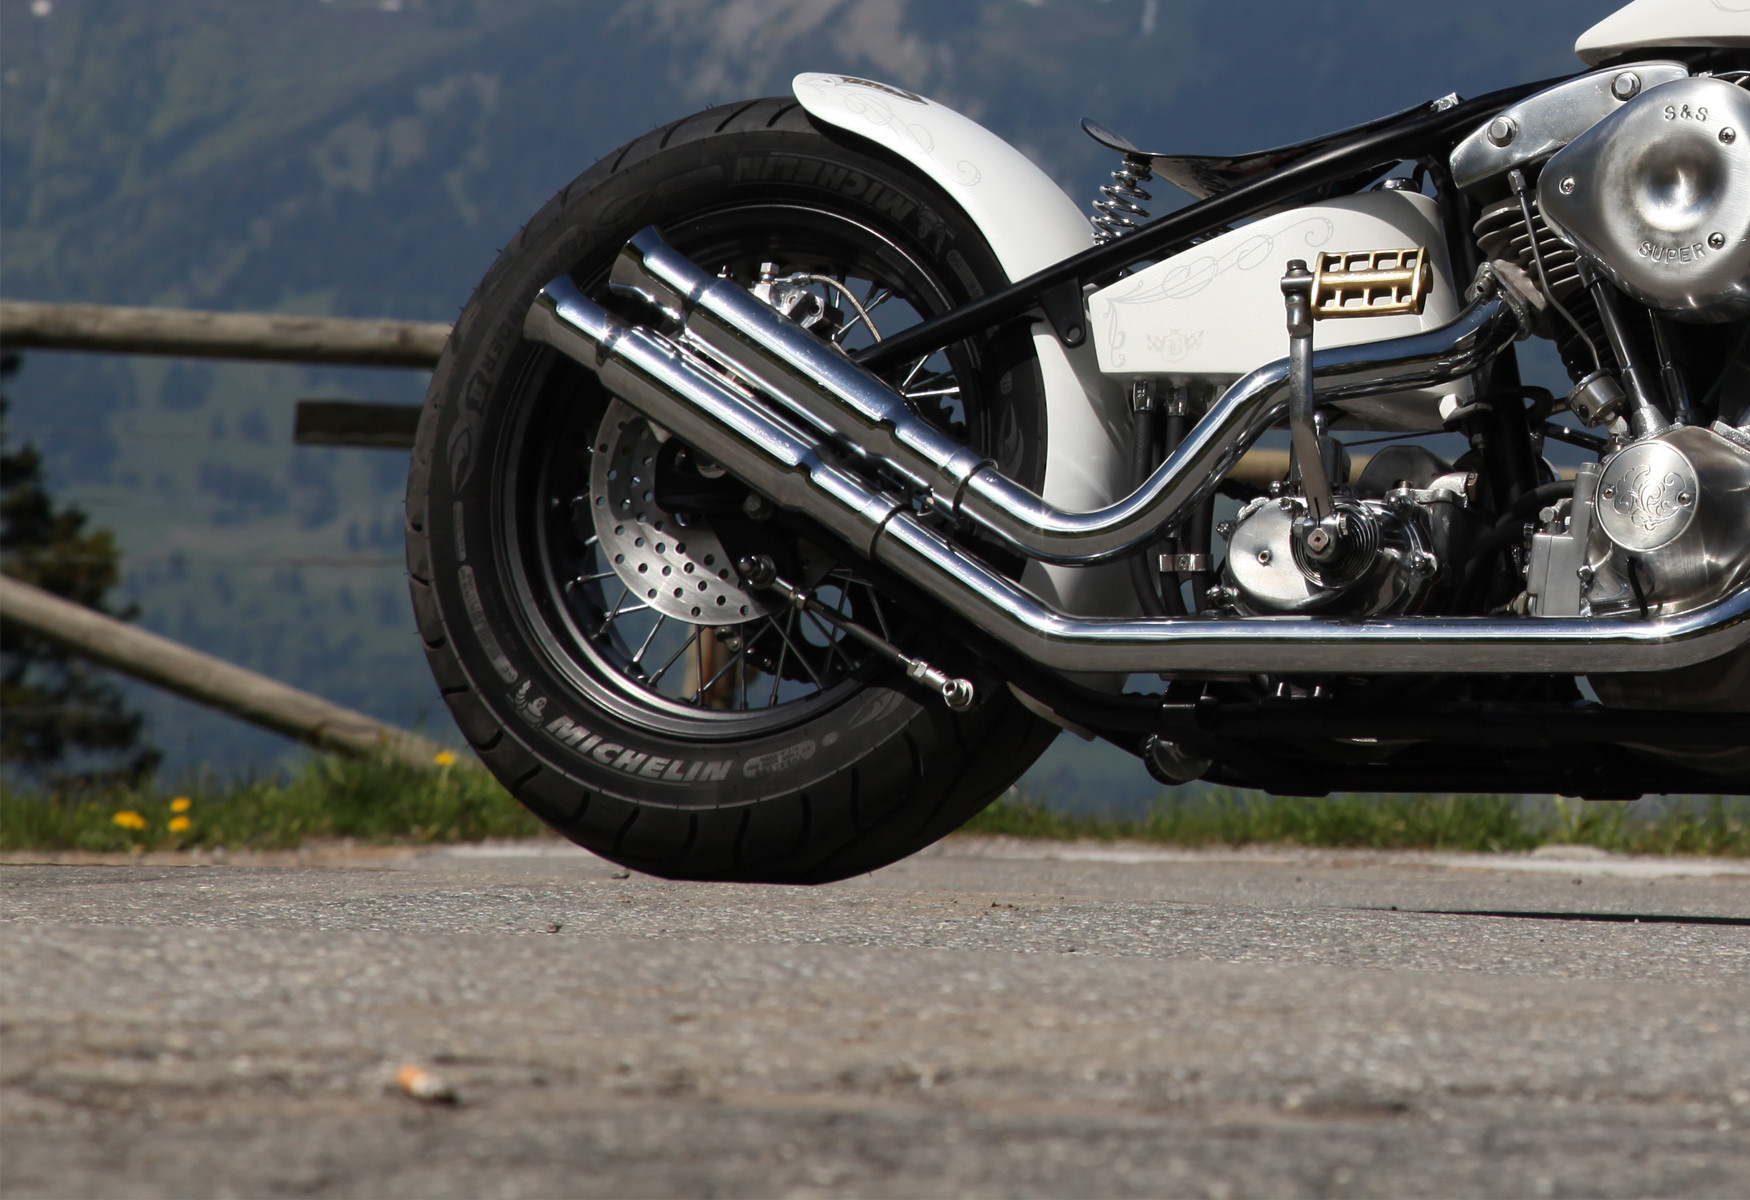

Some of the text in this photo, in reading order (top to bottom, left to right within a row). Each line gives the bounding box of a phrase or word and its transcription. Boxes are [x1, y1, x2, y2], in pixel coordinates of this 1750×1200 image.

[734, 156, 915, 223] MICHELIN
[1638, 240, 1706, 265] SUPER
[544, 714, 733, 782] MICHELIN
